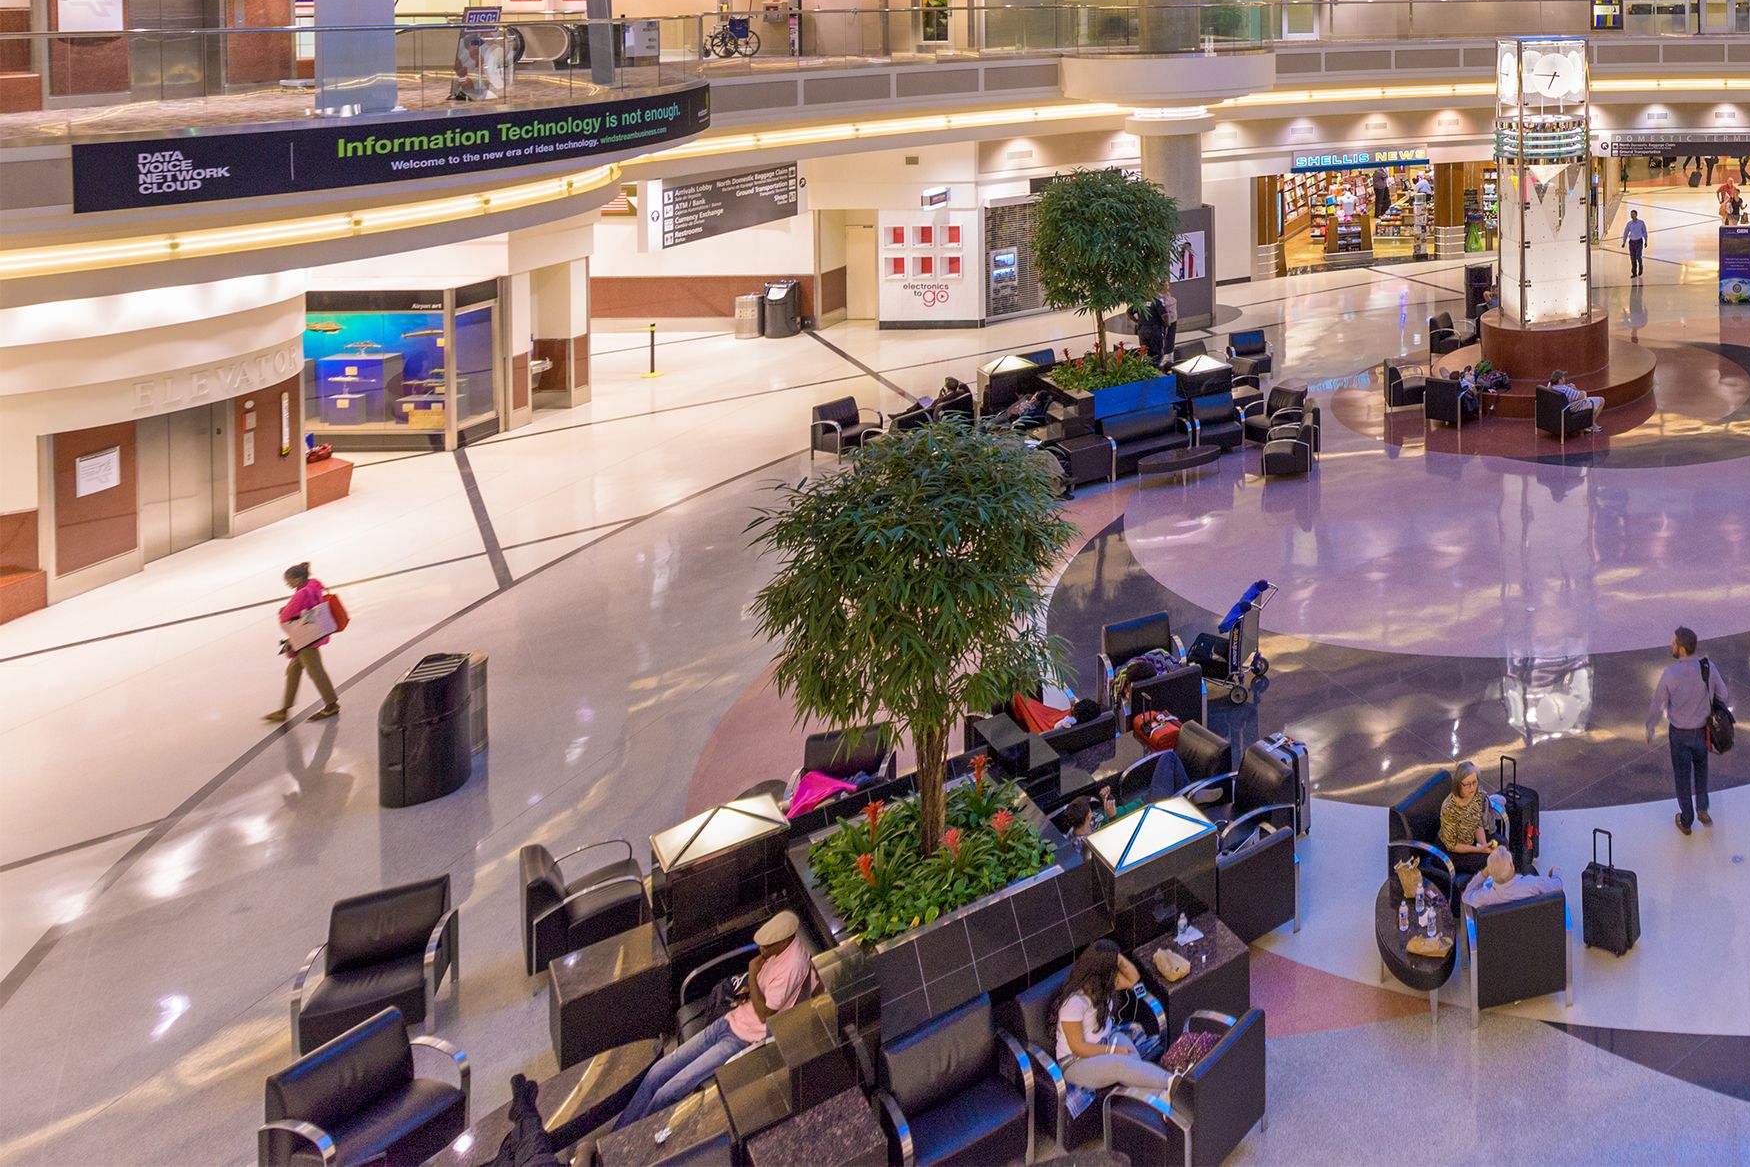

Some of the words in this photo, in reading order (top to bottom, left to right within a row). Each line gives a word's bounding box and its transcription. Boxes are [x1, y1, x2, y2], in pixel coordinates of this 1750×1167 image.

[337, 128, 489, 158] Information
[497, 116, 602, 142] Technology
[605, 112, 618, 128] is
[621, 109, 641, 126] not
[644, 102, 681, 123] enough.
[1615, 135, 1693, 143] DOMESTIC
[137, 150, 185, 164] DATA
[391, 158, 446, 171] Welcome
[448, 155, 460, 165] to
[463, 152, 480, 163] the
[482, 151, 503, 161] new
[506, 149, 522, 157] era
[524, 145, 534, 155] of
[535, 144, 554, 154] idea
[556, 138, 600, 151] technology.
[600, 126, 667, 145] windstreambusiness.com
[137, 159, 193, 174] VOICE
[1296, 153, 1370, 167] SHELLIS
[1375, 149, 1426, 162] NEWS
[138, 166, 231, 184] NETWORK
[716, 179, 732, 188] North
[732, 175, 754, 185] Domestic
[755, 171, 774, 182] Baggage
[775, 167, 788, 176] Claim
[138, 179, 202, 195] CLOUD
[675, 187, 696, 197] Arrivals
[696, 184, 713, 193] Lobby
[735, 187, 755, 198] Ground
[755, 180, 788, 193] Transportation
[675, 202, 687, 211] ATM
[692, 198, 706, 207] Bank
[774, 193, 788, 202] Shops
[675, 214, 698, 225] Currency
[699, 207, 724, 218] Exchange
[675, 226, 703, 237] Restrooms
[922, 290, 950, 307] go
[132, 345, 298, 411] ELEVATOR
